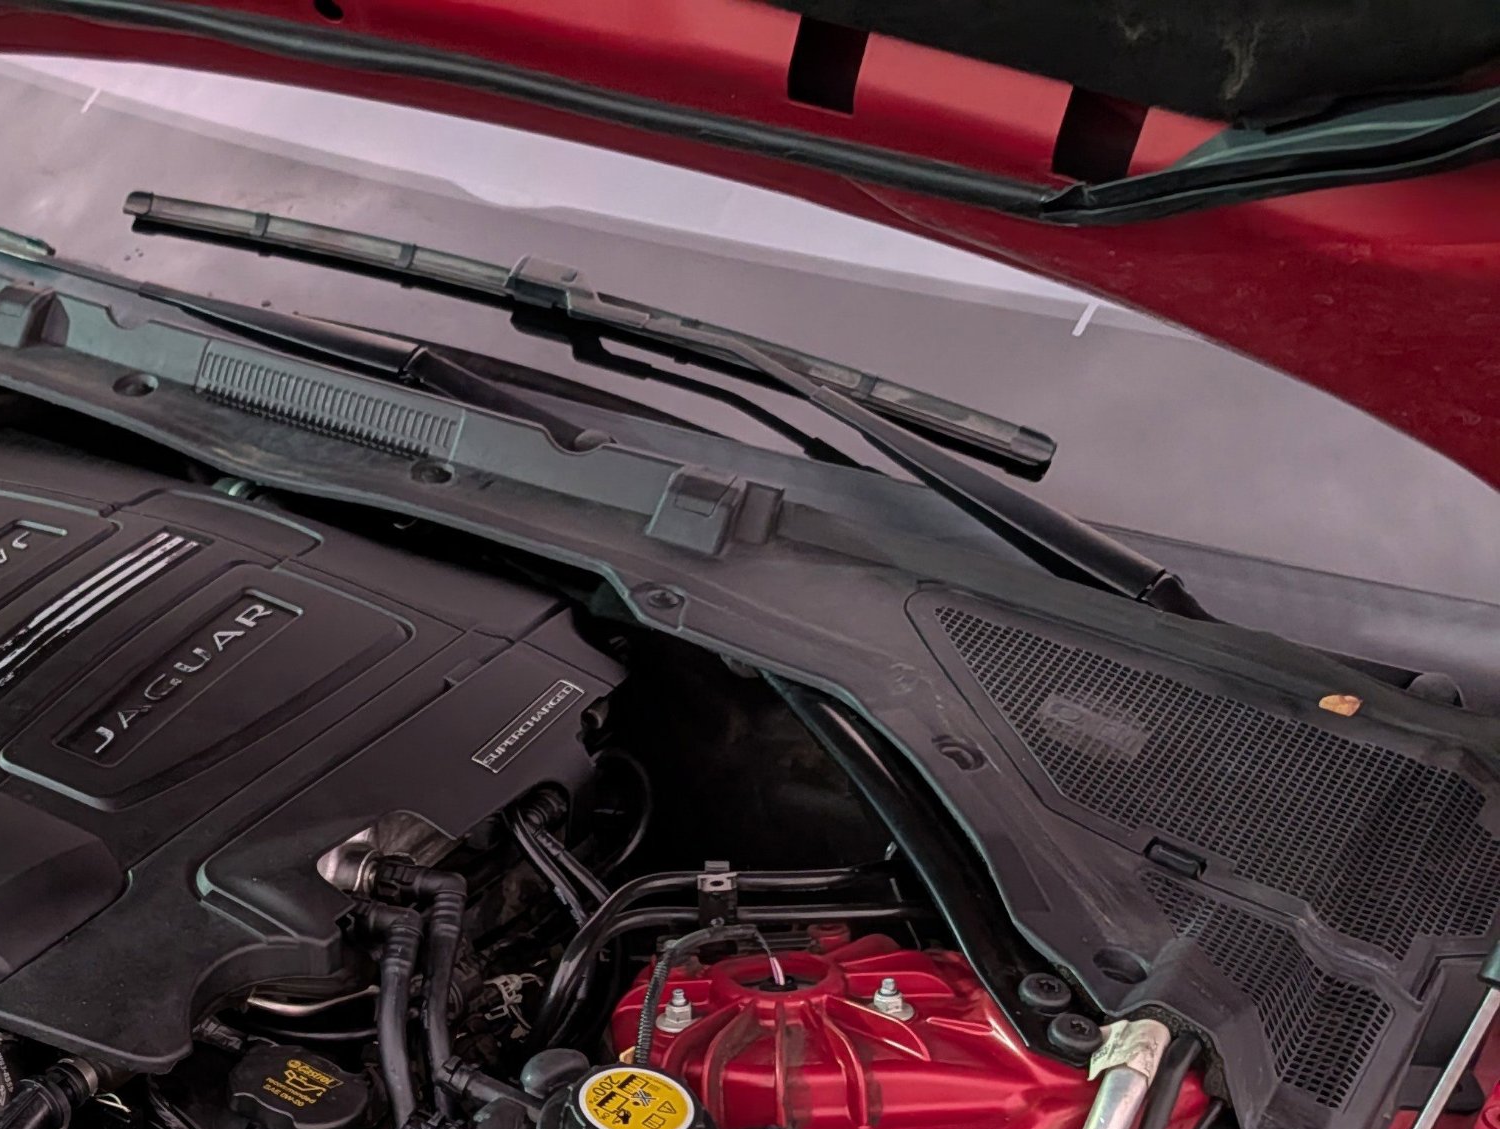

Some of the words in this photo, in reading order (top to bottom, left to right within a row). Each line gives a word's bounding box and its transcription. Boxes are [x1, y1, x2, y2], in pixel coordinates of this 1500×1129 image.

[95, 604, 273, 754] JAGUAR
[482, 685, 574, 766] SUPERCHARGED
[298, 1065, 334, 1085] Castrol
[592, 1075, 620, 1097] 200
[263, 1084, 281, 1096] SAE
[266, 1077, 317, 1104] recommended
